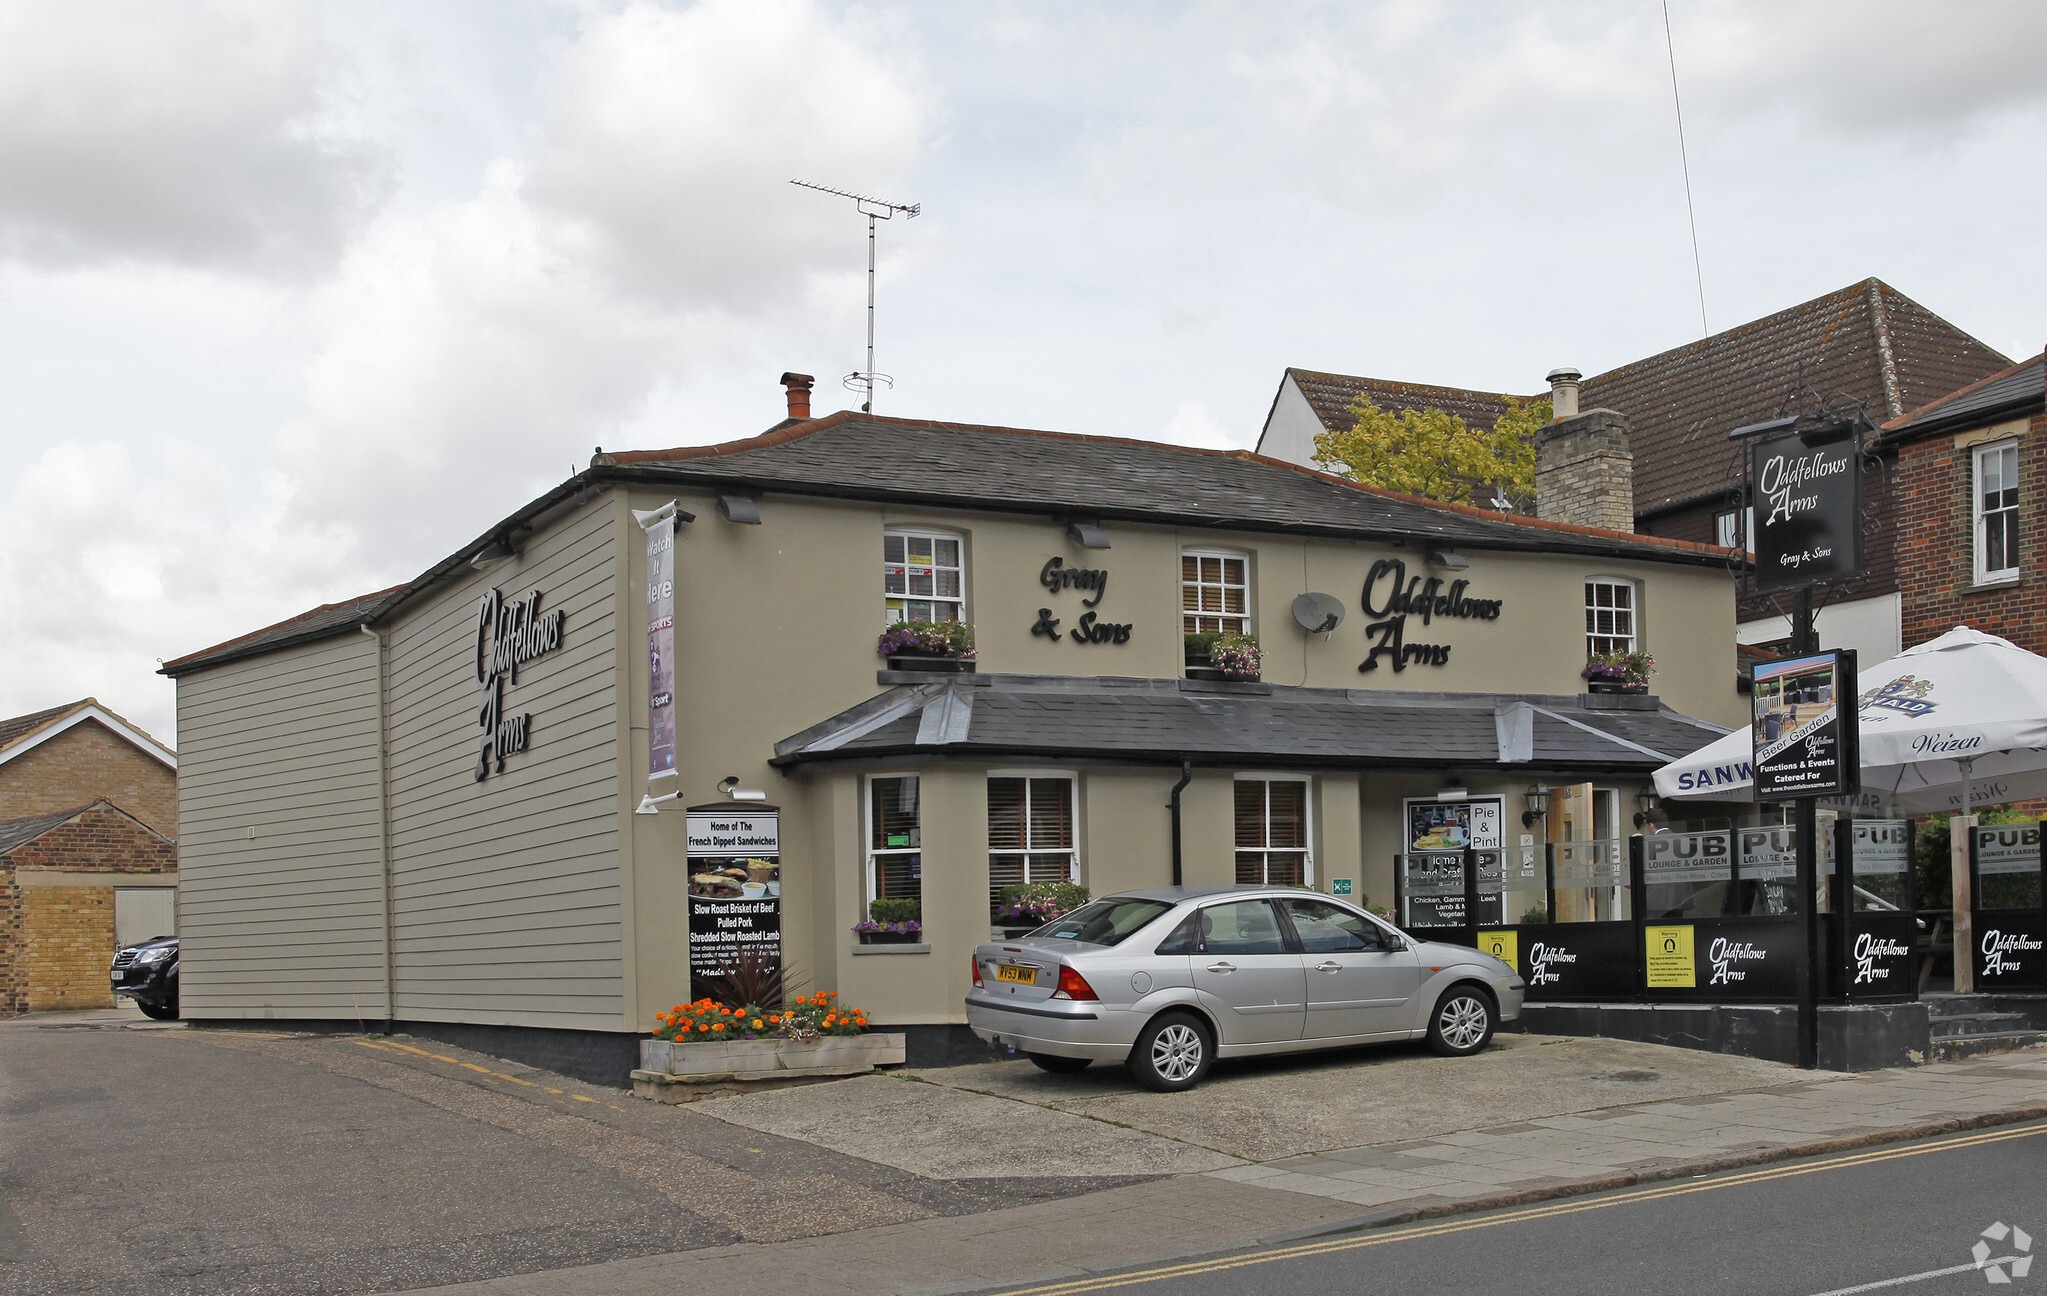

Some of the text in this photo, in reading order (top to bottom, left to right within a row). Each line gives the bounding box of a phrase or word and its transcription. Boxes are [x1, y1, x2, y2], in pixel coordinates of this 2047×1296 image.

[1761, 452, 1847, 494] Oddfellows
[1766, 485, 1818, 526] Arms
[1780, 547, 1832, 568] Gray & Sons
[1040, 556, 1108, 607] Gray
[1361, 558, 1503, 625] Oddfellows
[1030, 608, 1133, 645] & Sons
[475, 587, 565, 691] Oddfellows
[1358, 614, 1451, 673] Arms
[475, 675, 530, 782] Arms
[1762, 714, 1830, 759] Beer Garden
[1912, 734, 1981, 754] Weizen
[1678, 761, 1754, 790] SANW
[1760, 763, 1798, 773] Functions
[1808, 758, 1835, 767] Events
[1774, 772, 1820, 783] Catered For
[1474, 807, 1494, 818] Pie
[711, 821, 752, 831] Home of The
[1480, 821, 1489, 832] &
[1853, 827, 1908, 844] PUB
[689, 836, 776, 848] French Dipped Sandwiches
[1473, 836, 1497, 847] Pint
[1648, 836, 1727, 860] PUB
[1980, 829, 2040, 848] PUB
[1648, 860, 1682, 868] LOUNGE
[1692, 857, 1727, 866] GARDEN
[694, 902, 774, 914] Slow Roast Brisket of Beef
[717, 917, 753, 928] Pulled Pork
[690, 930, 780, 942] Shredded Slow Roasted Lamb
[1854, 933, 1909, 960] Oddfellows
[1981, 930, 2043, 955] Oddfellows
[1530, 942, 1577, 966] Oddfellows
[1709, 937, 1766, 963] Oddfellows
[1530, 962, 1559, 985] Arms
[1709, 960, 1746, 985] Arms
[1854, 956, 1889, 984] Arms
[1982, 950, 2021, 976] Arms
